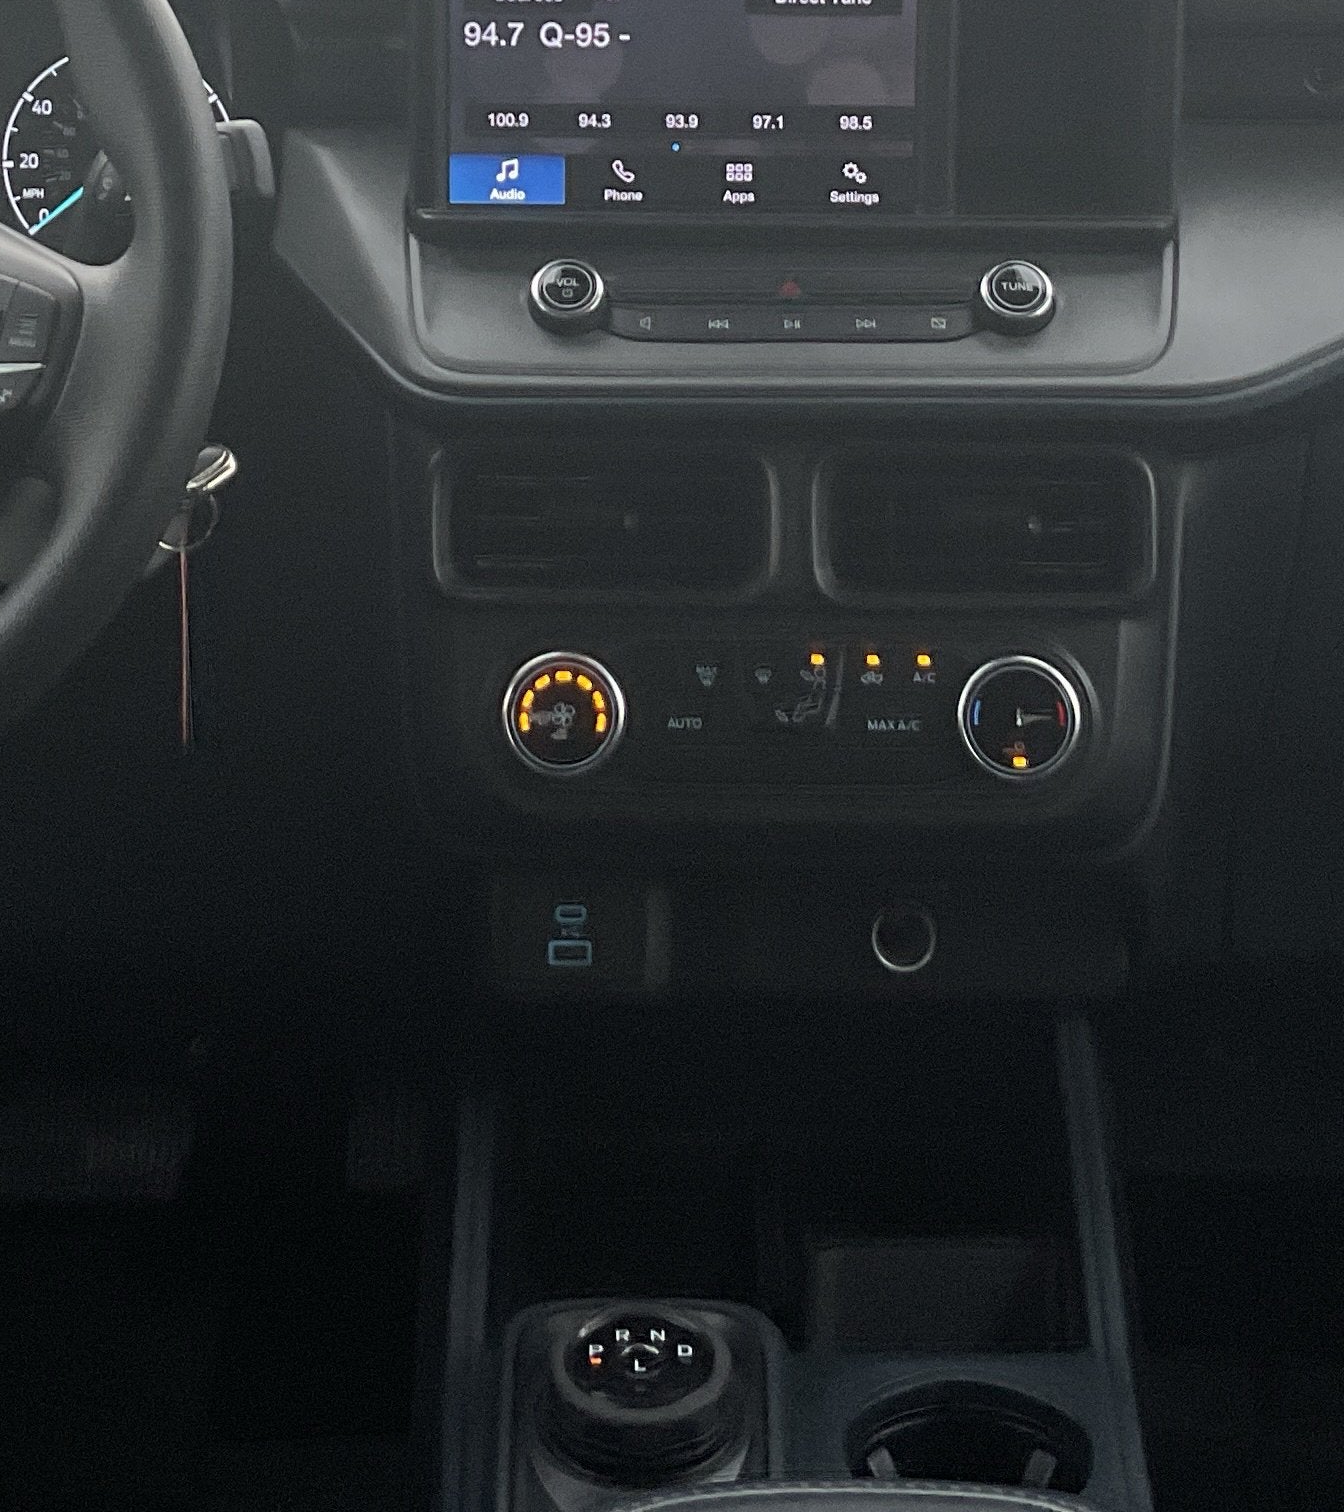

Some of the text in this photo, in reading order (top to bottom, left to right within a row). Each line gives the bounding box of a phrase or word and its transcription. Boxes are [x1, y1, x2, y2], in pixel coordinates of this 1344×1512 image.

[463, 21, 525, 47] 94.7
[539, 21, 611, 48] Q-95
[31, 99, 53, 116] 40
[487, 112, 529, 128] 100.9
[578, 113, 612, 129] 94.3
[665, 113, 699, 129] 93.9
[752, 114, 784, 130] 97.1
[839, 115, 873, 131] 98.5
[19, 152, 39, 169] 20
[22, 187, 45, 199] MPH
[489, 187, 526, 201] Audio
[603, 188, 643, 202] Phone
[722, 189, 755, 205] Apps
[829, 190, 880, 206] Settings
[38, 208, 50, 222] 0
[556, 276, 580, 288] VOL
[1001, 281, 1033, 292] TUNE
[913, 671, 936, 684] A/C
[667, 716, 703, 729] AUTO
[867, 719, 920, 731] MAX A/C
[615, 1329, 630, 1342] R
[650, 1329, 666, 1342] N
[588, 1344, 604, 1357] P
[677, 1344, 693, 1357] D
[634, 1358, 646, 1372] L
